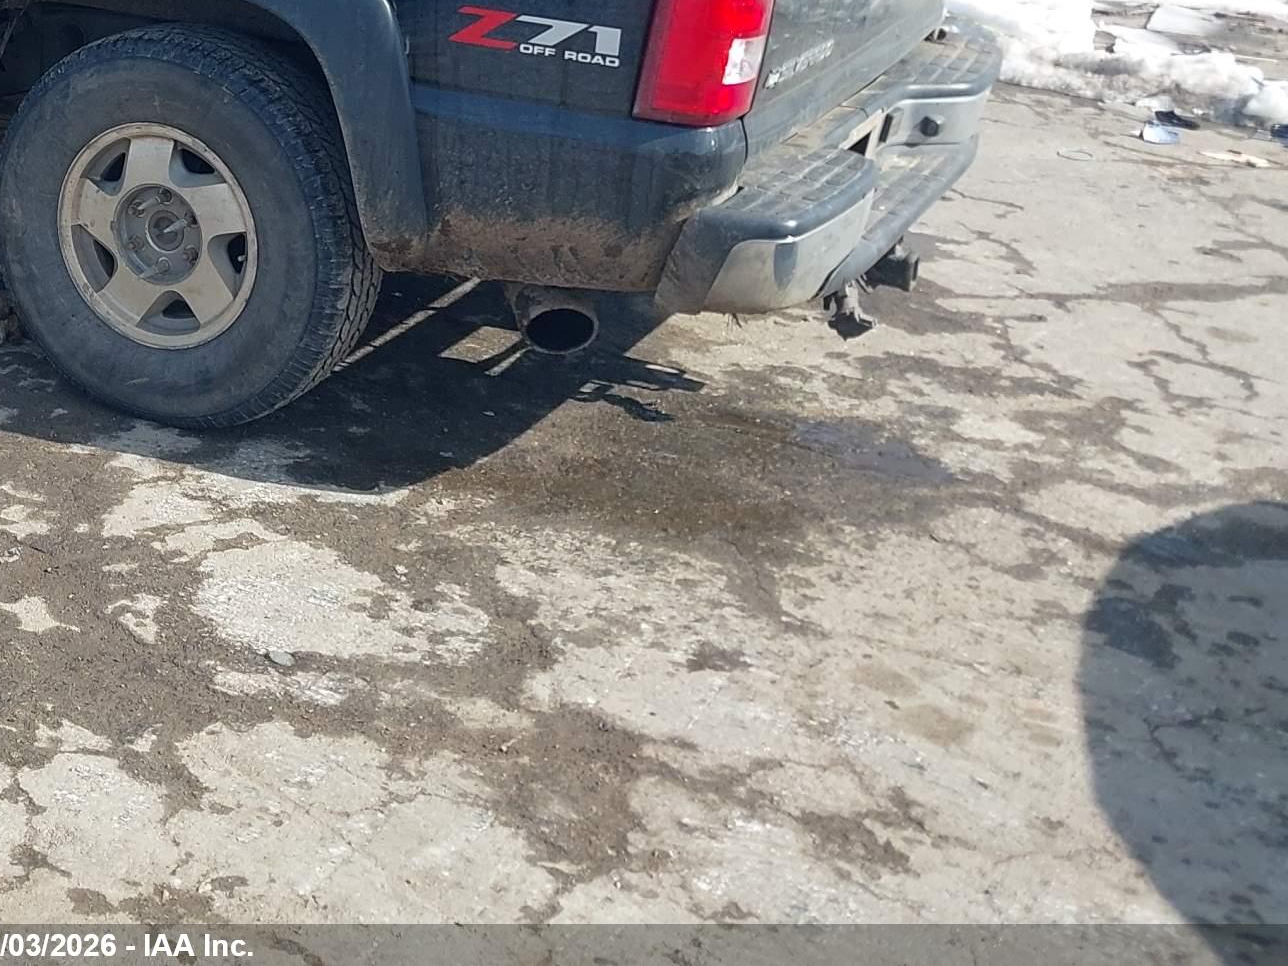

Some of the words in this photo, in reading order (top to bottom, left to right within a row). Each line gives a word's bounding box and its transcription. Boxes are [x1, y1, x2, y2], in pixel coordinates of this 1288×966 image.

[448, 6, 623, 56] Z71
[519, 43, 557, 57] OFF
[564, 51, 621, 68] ROAD
